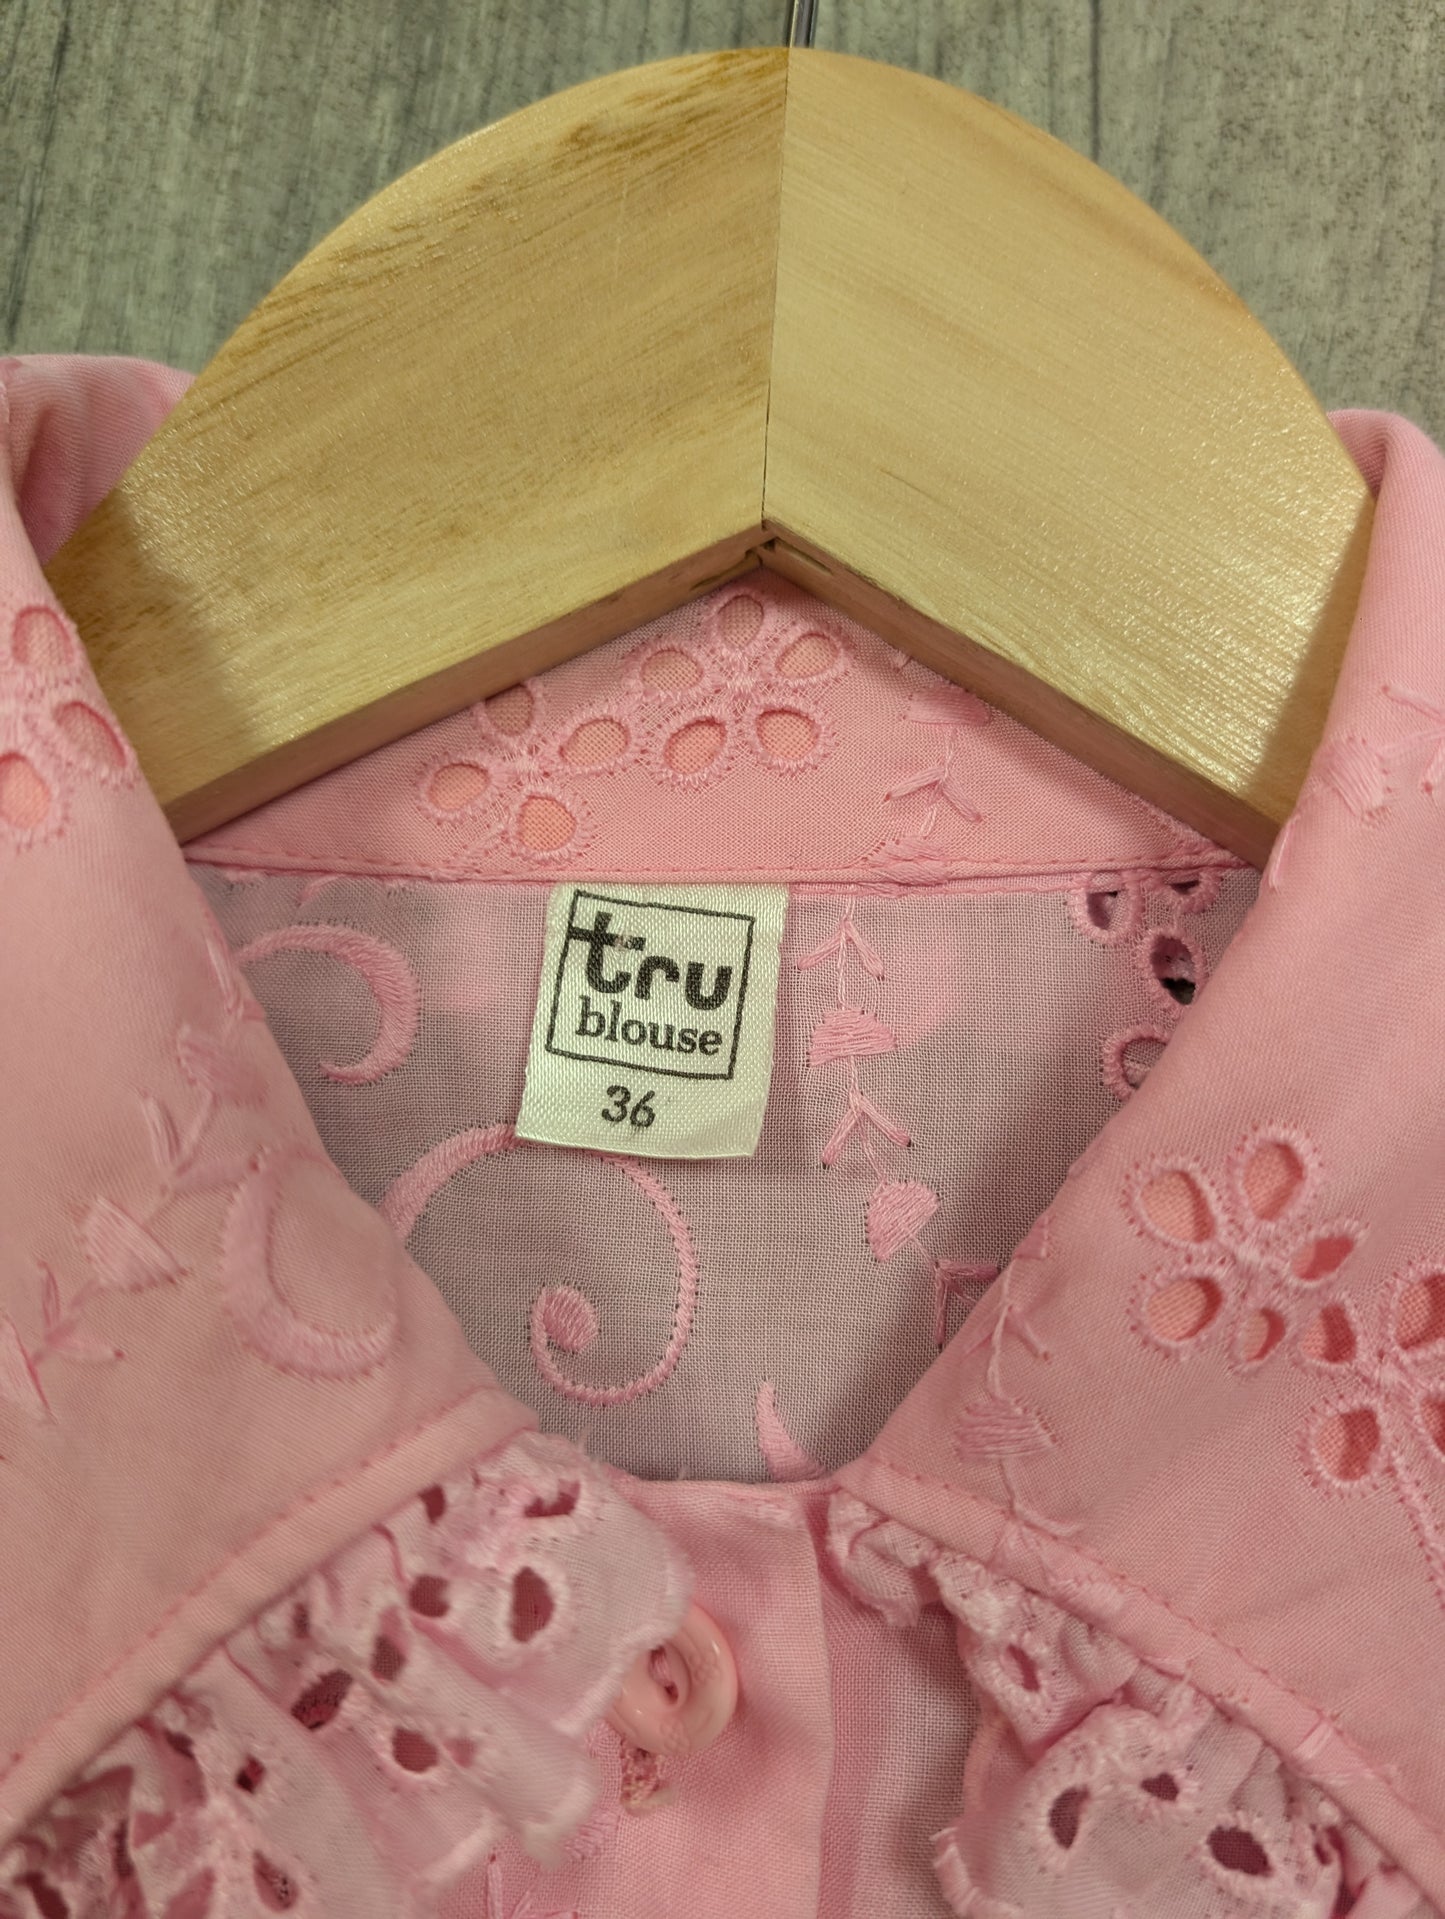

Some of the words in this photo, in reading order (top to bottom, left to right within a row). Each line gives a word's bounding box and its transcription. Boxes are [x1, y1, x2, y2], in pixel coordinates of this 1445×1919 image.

[569, 911, 733, 1011] tru
[575, 995, 723, 1056] blouse
[601, 1084, 656, 1128] 36
